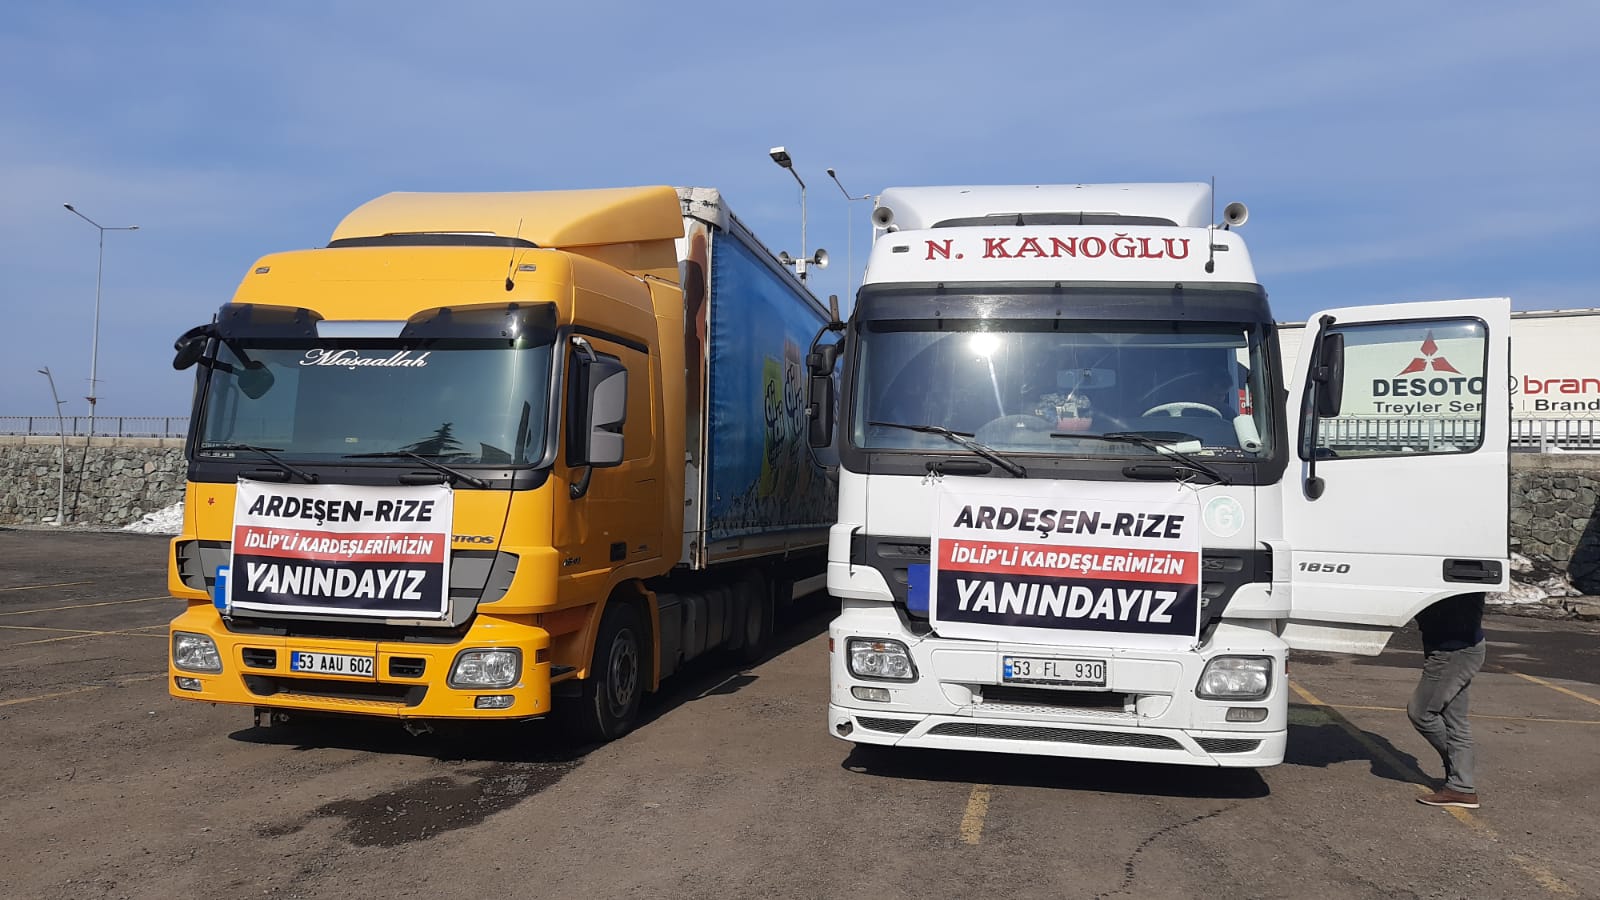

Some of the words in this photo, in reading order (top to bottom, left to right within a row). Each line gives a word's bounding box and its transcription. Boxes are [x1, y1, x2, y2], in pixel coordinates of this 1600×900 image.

[924, 239, 964, 260] N.
[982, 232, 1190, 260] KANOĞLU
[299, 348, 431, 370] Maşaallah
[1372, 377, 1483, 397] DESOTO
[1374, 401, 1442, 416] Treyler
[1215, 504, 1233, 527] G
[298, 536, 433, 558] KARDEŞLERİMİZİN
[452, 535, 495, 544] TROS
[951, 543, 1019, 567] İDLİP'Lİ
[1021, 551, 1184, 574] KARDEŞLERİMİZİN
[1298, 562, 1350, 574] 1850
[246, 562, 426, 600] YANINDAYIZ
[956, 579, 1178, 624] YANINDAYIZ
[299, 654, 314, 669] 53
[320, 656, 344, 671] AAU
[349, 658, 372, 674] 602
[1013, 661, 1030, 676] 53
[1044, 662, 1061, 677] FL
[1075, 663, 1102, 679] 930
